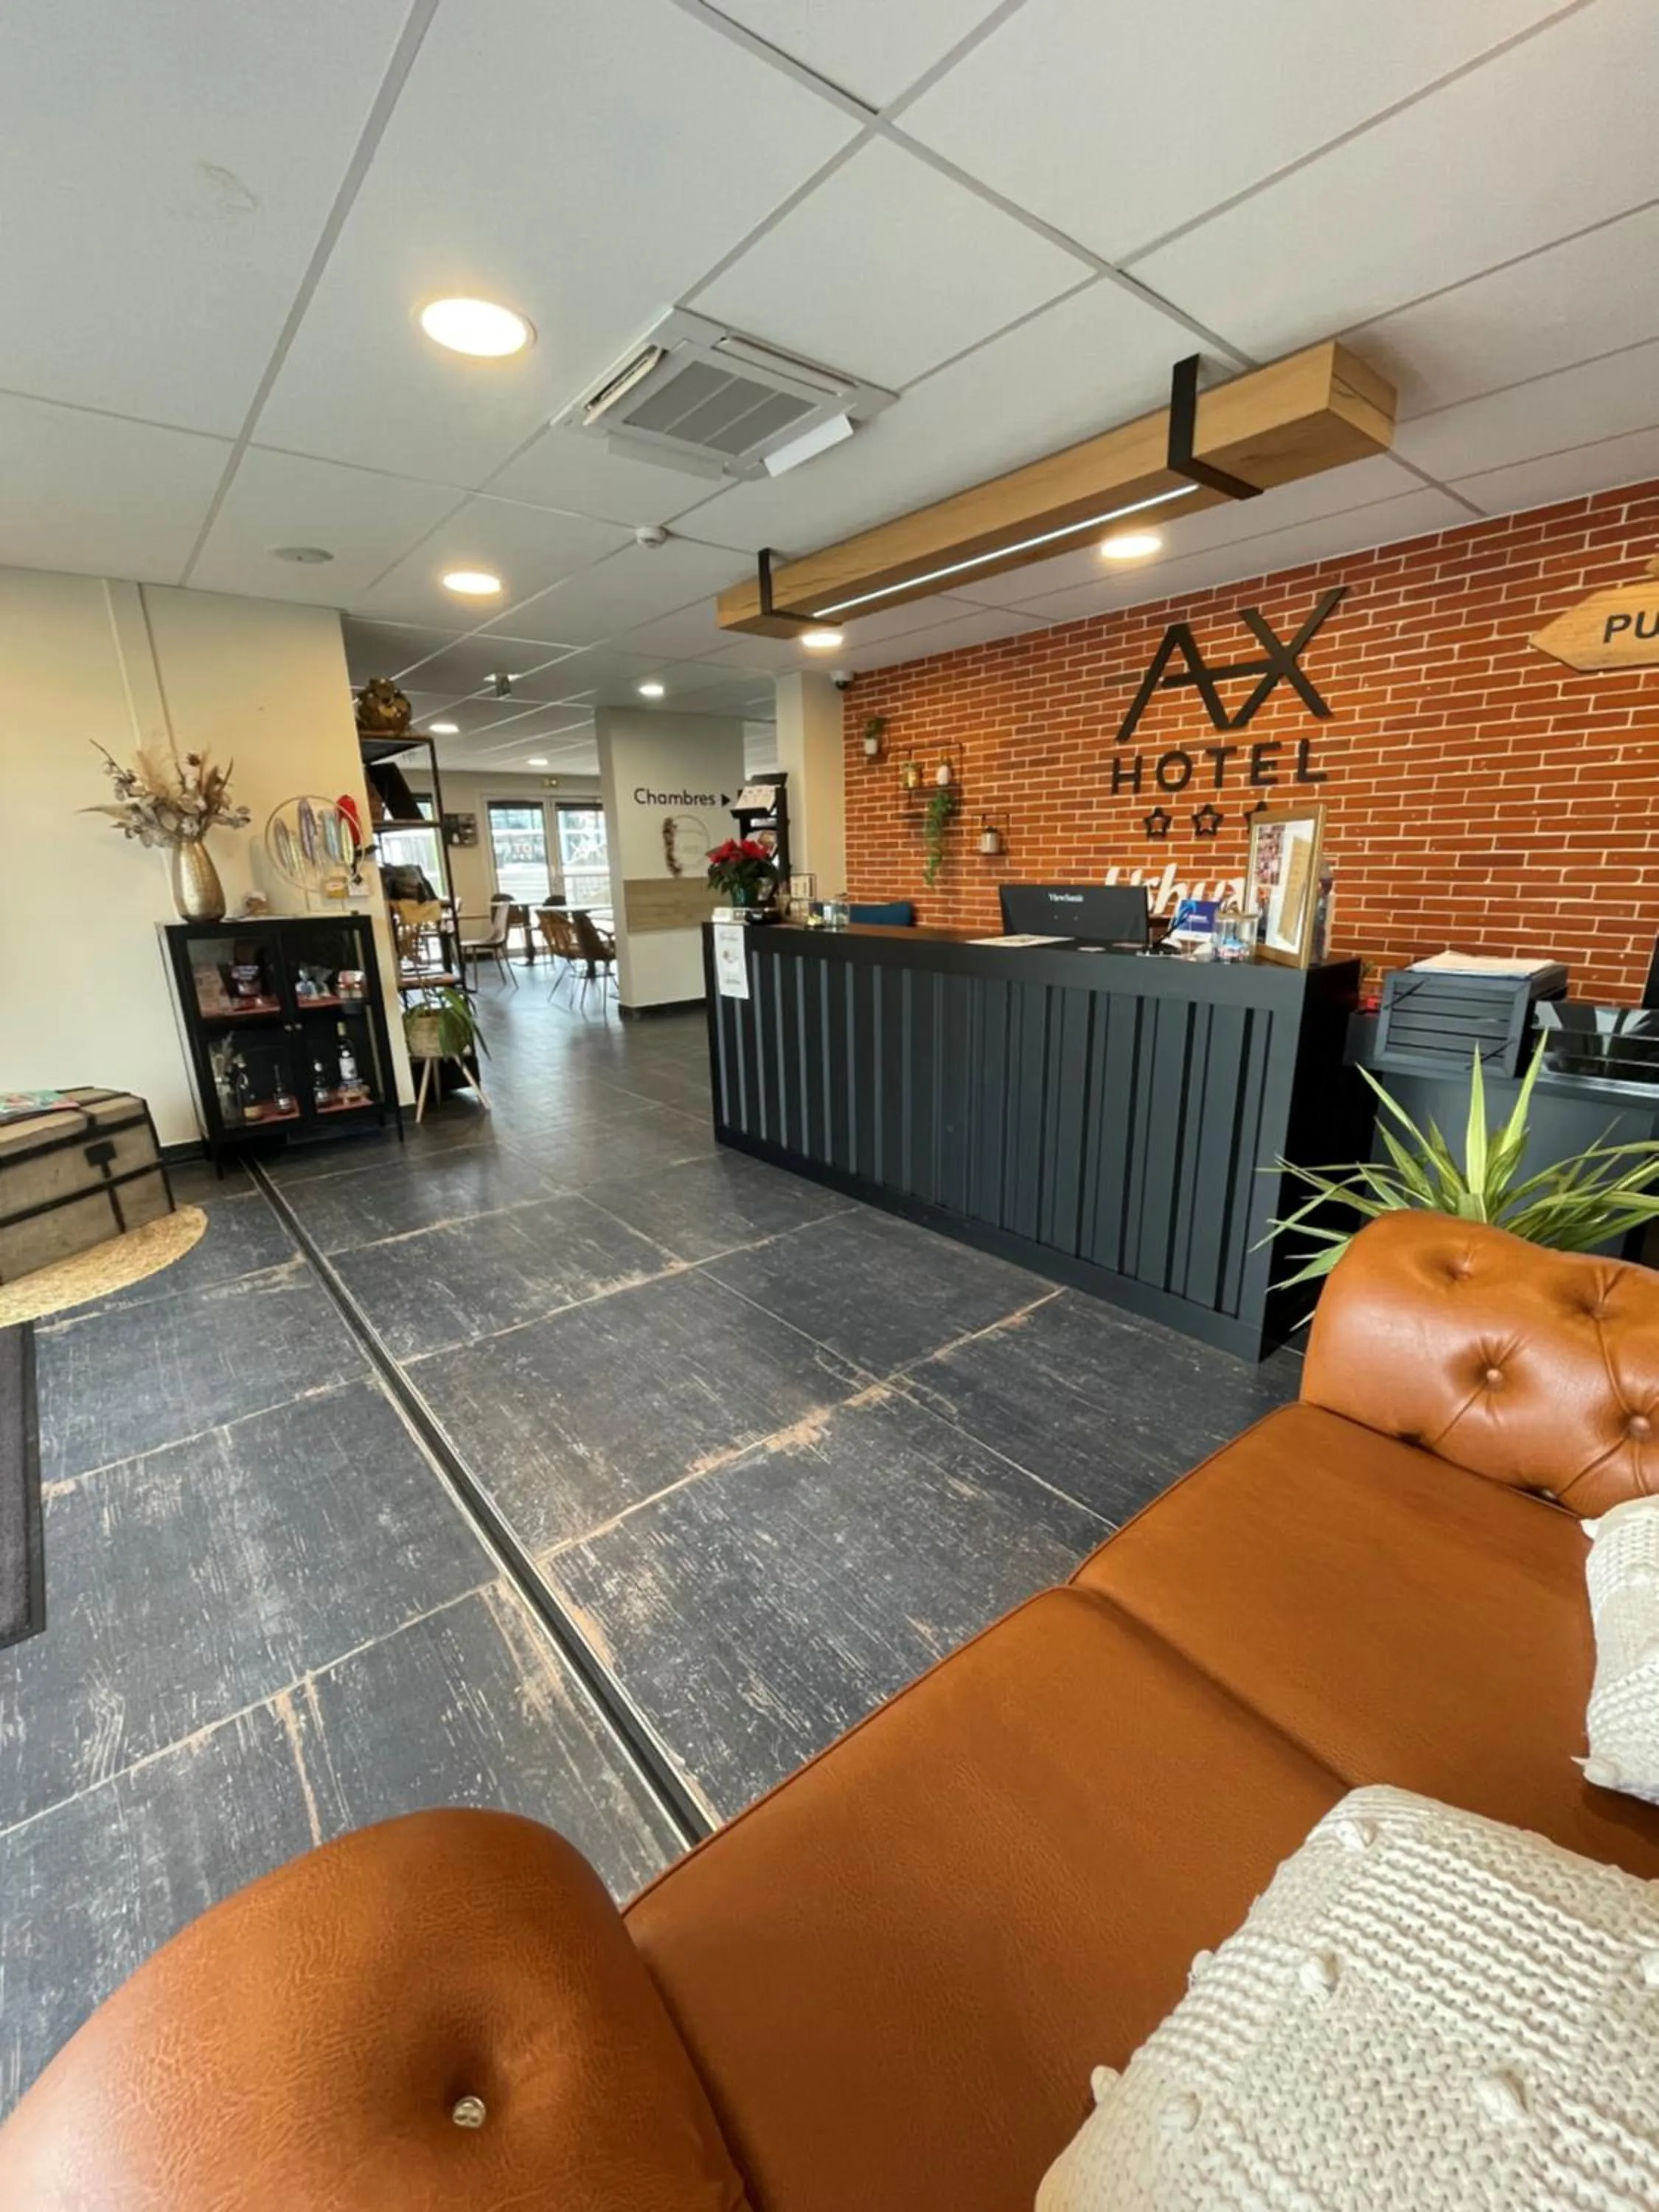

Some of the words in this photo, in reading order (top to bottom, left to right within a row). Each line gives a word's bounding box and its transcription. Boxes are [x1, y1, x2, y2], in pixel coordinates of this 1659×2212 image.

[1603, 611, 1659, 644] PU
[1116, 585, 1350, 742] AX
[1110, 738, 1327, 794] HOTEL
[633, 787, 716, 806] Chambres
